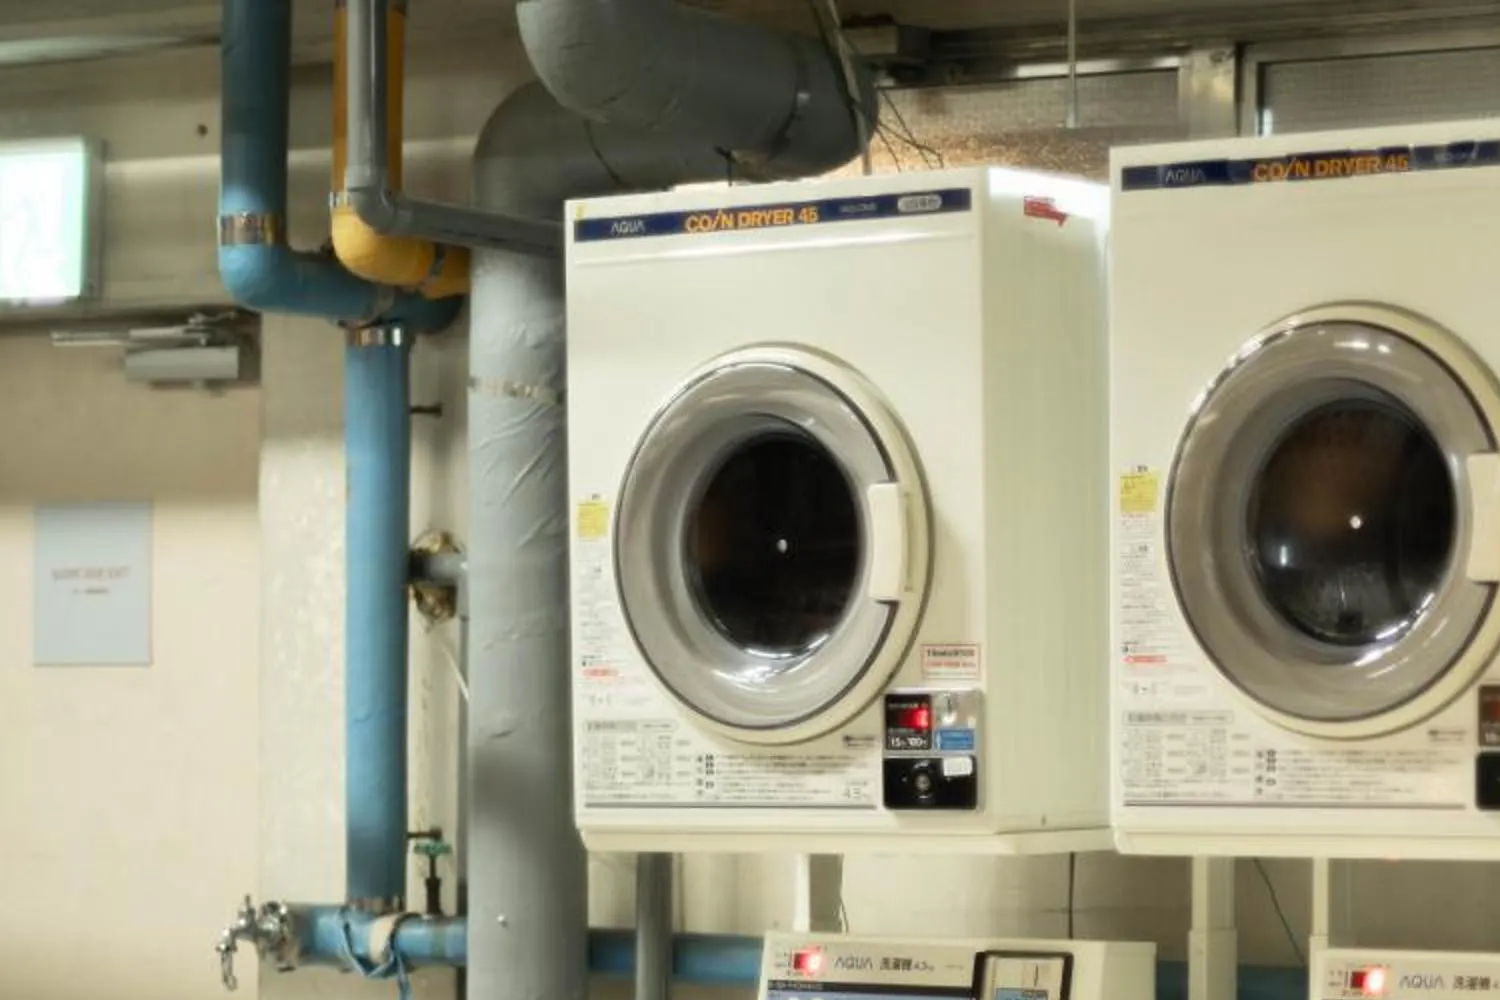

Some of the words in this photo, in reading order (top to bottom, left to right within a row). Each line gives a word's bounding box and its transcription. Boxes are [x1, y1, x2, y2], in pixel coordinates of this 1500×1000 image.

[1314, 155, 1381, 177] DRYER
[737, 207, 795, 229] DRYER
[611, 220, 647, 237] AQUA
[833, 956, 873, 970] AQUA
[1400, 974, 1445, 990] AQUA
